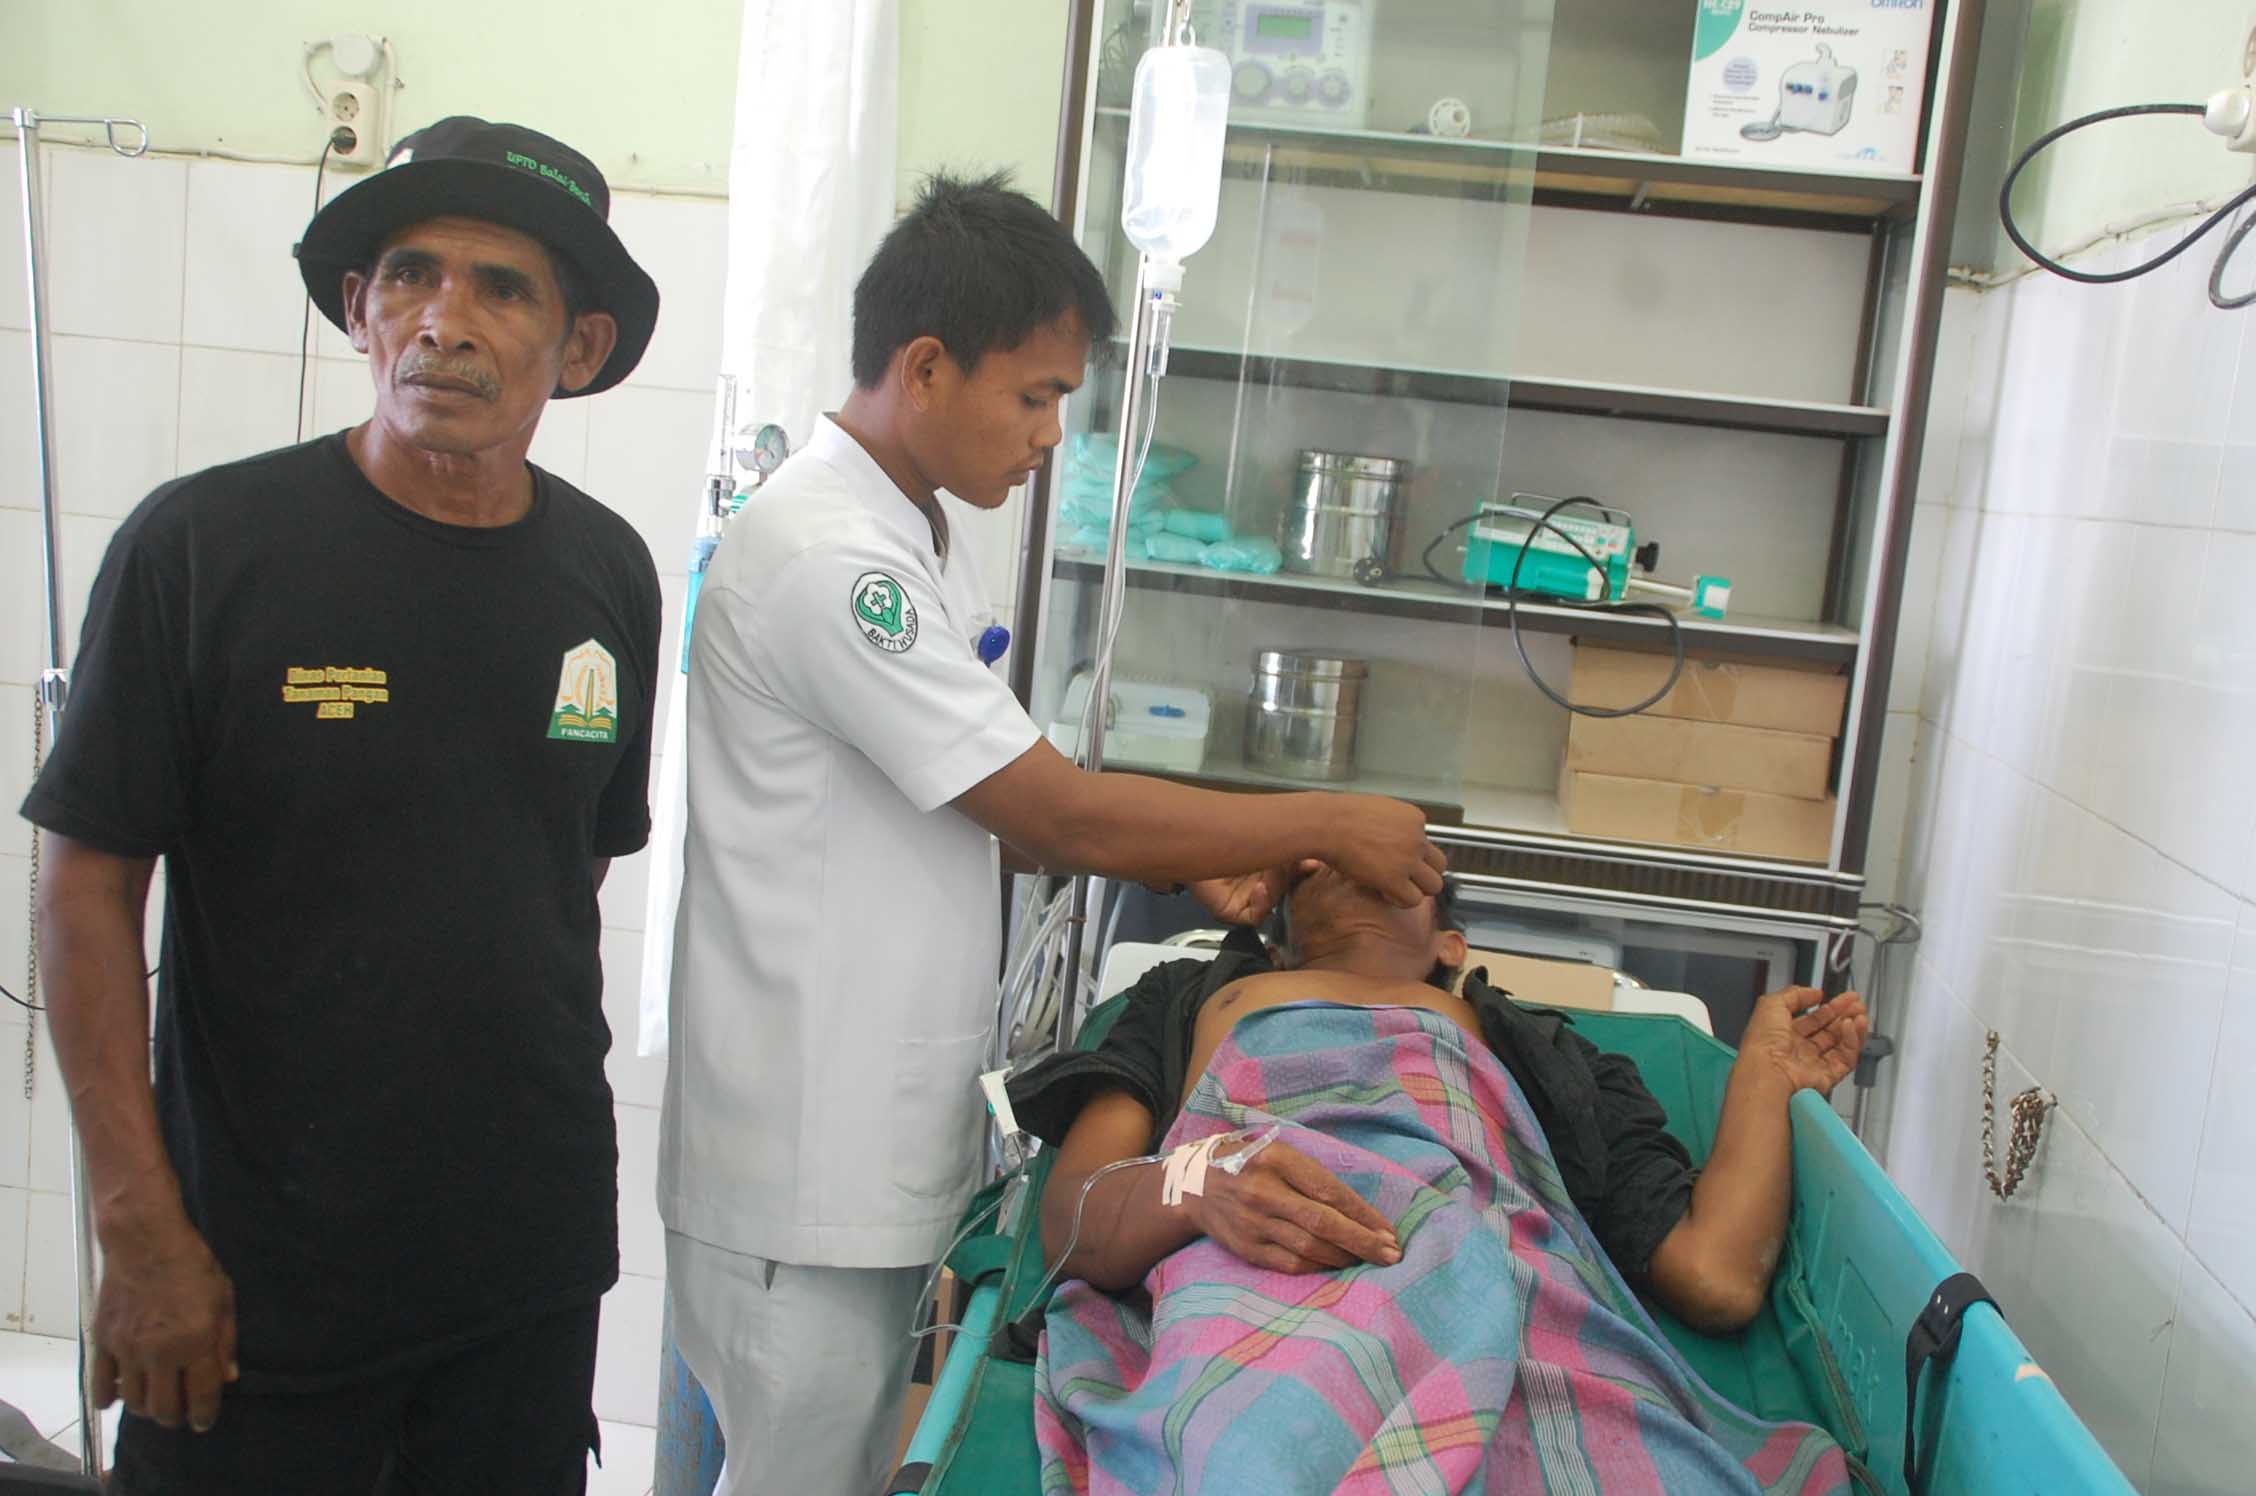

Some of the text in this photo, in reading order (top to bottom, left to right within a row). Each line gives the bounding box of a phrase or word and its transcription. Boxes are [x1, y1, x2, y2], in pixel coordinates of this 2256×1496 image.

[1750, 10, 1825, 27] CompAir Pro
[1748, 22, 1860, 37] Compressor Nebulizer
[868, 628, 897, 650] BAKTI
